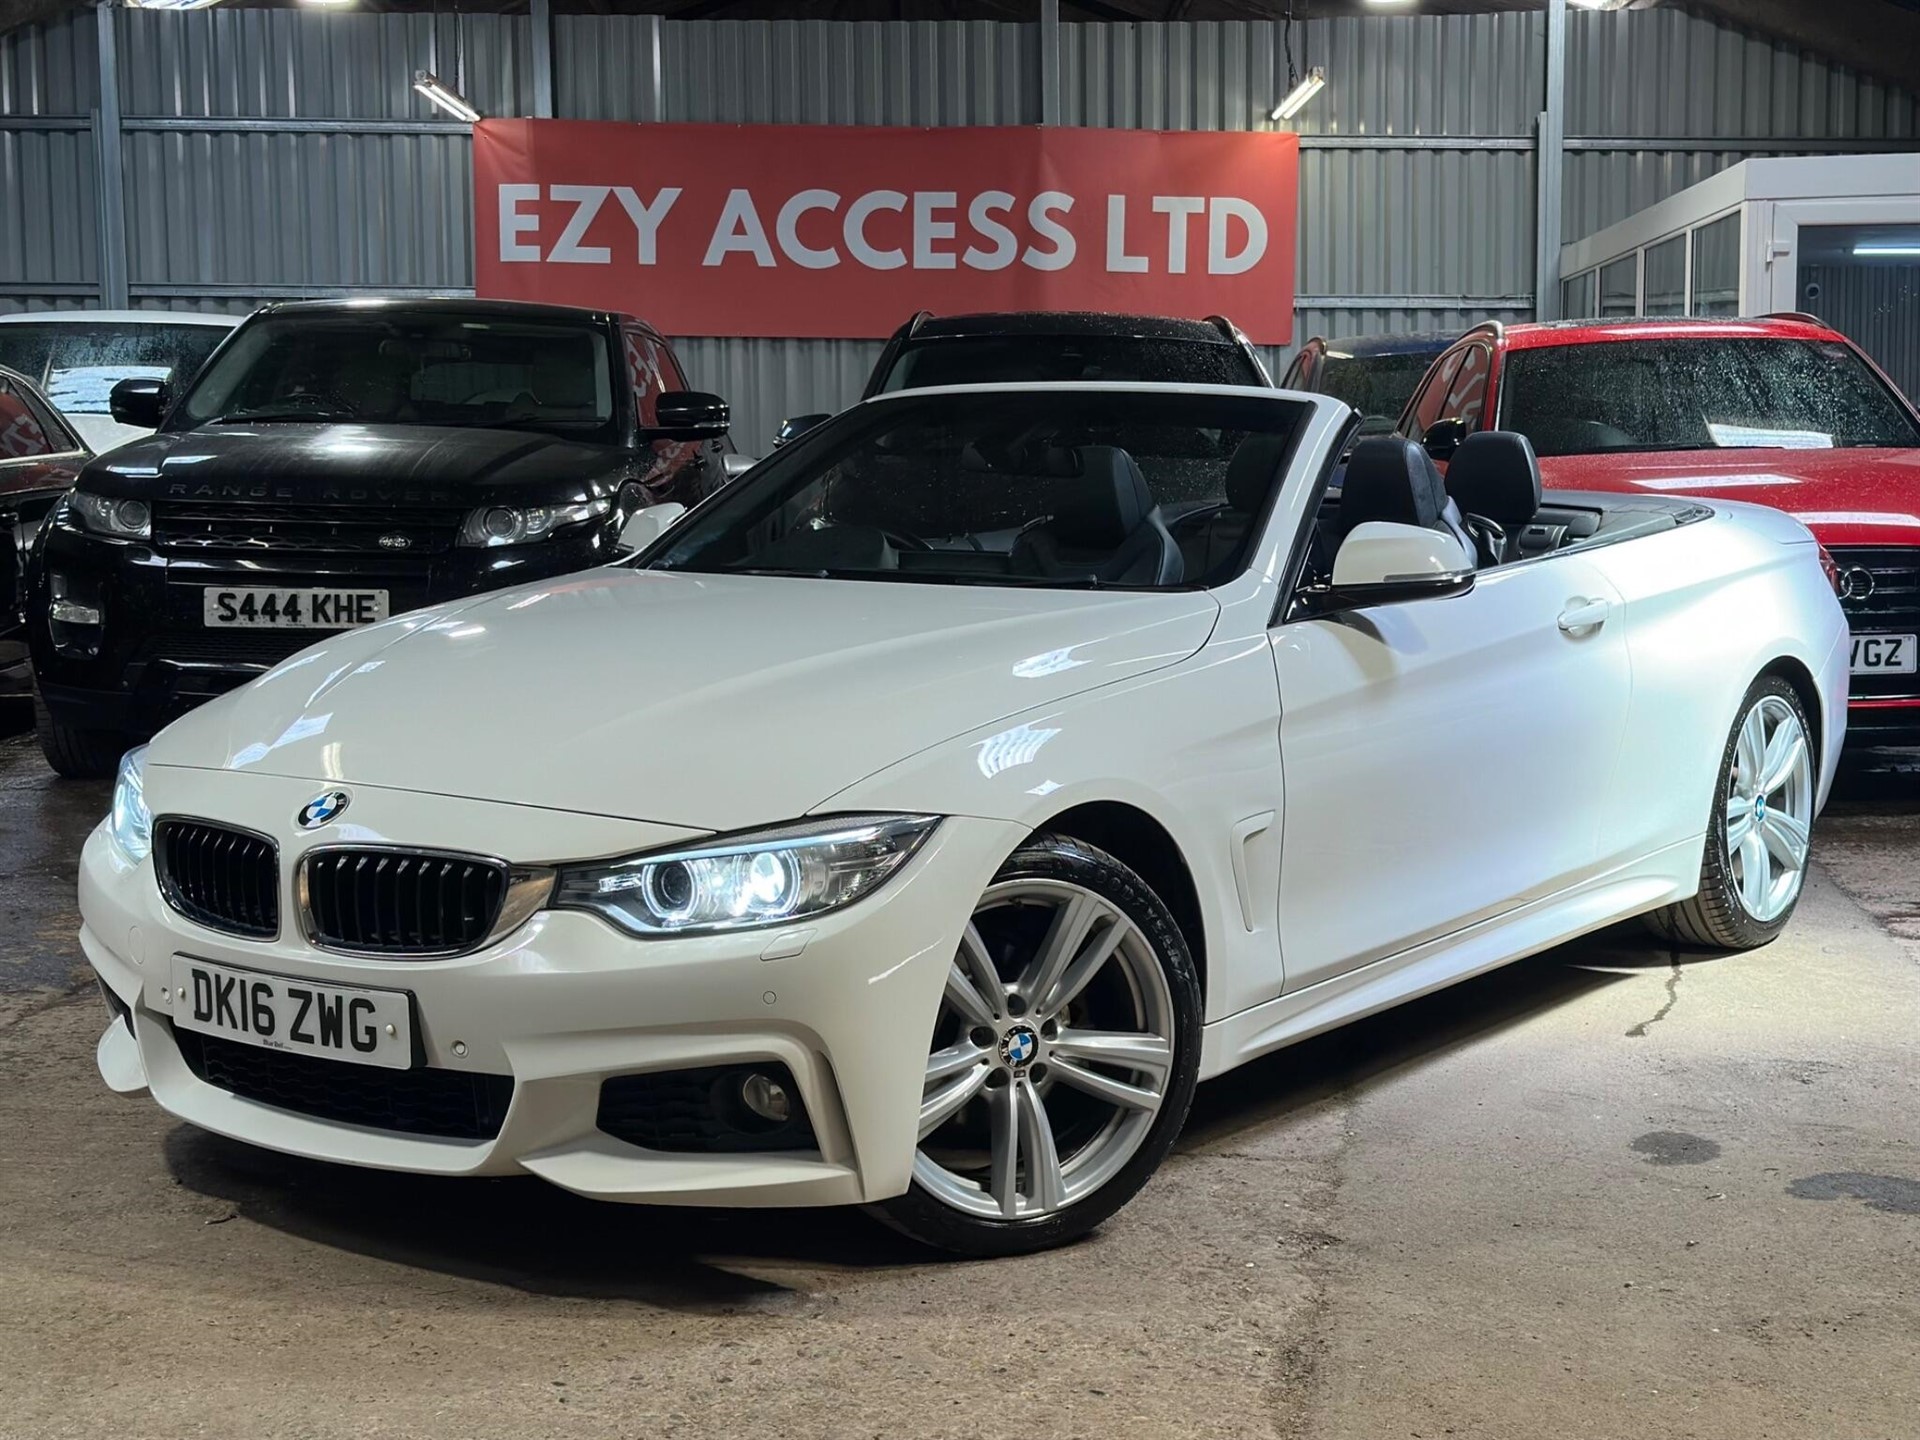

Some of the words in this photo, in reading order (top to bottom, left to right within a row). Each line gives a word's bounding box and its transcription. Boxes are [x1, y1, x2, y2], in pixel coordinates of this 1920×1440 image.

[498, 183, 683, 266] EZY
[702, 188, 1077, 272] ACCESS
[1105, 193, 1269, 275] LTD
[169, 483, 294, 498] RANGE
[323, 488, 450, 502] ROVER
[217, 592, 302, 622] S444
[312, 594, 375, 623] KHE
[192, 968, 276, 1036] DK16
[287, 987, 378, 1053] ZWG
